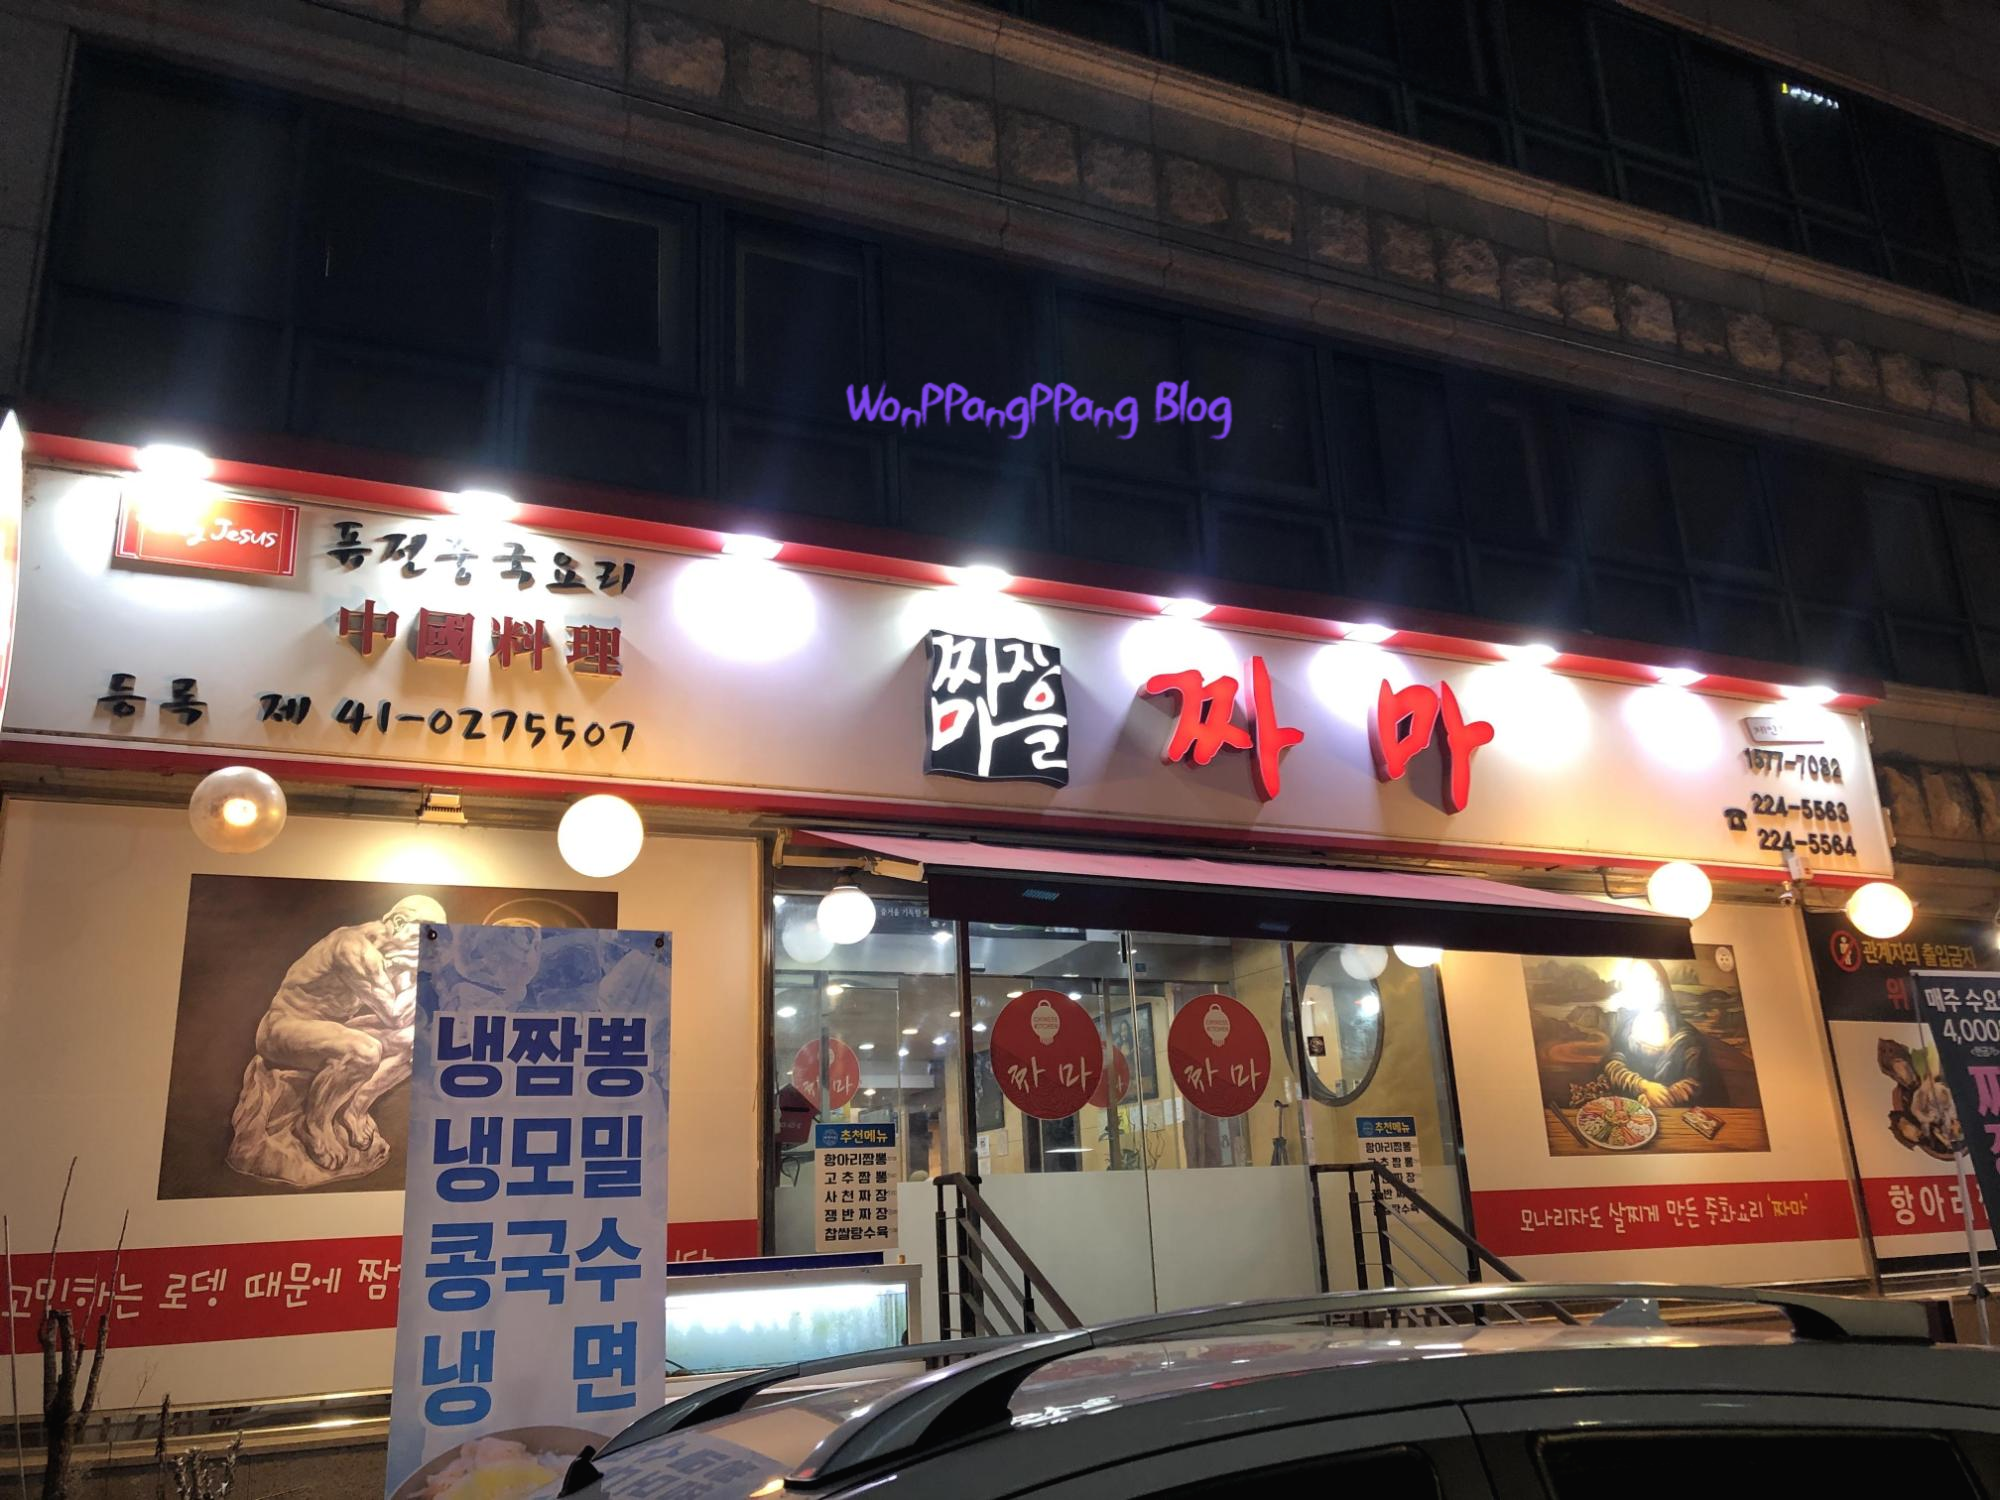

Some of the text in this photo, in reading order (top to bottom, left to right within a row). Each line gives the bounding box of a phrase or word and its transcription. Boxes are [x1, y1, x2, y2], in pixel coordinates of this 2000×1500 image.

[210, 517, 279, 548] Jesus
[338, 599, 624, 680] 中國料理
[259, 693, 311, 725] 제
[334, 697, 636, 754] 41-0275507
[1743, 748, 1843, 784] 1577-7082
[1751, 793, 1850, 823] 224-5563
[1757, 829, 1857, 857] 224-5564
[1861, 940, 1977, 968] 관계자외 출입금지
[1924, 987, 2000, 1014] 매주 수요
[1943, 1019, 2000, 1045] 4,000
[436, 1015, 649, 1099] 냉짬뽕
[840, 1128, 889, 1144] 추천메뉴
[1374, 1121, 1411, 1135] 추천메뉴
[433, 1115, 645, 1203] 냉모밀
[823, 1152, 887, 1168] 항아리짬뽕
[1520, 1206, 1604, 1232] 모나리자도
[1608, 1202, 1660, 1234] 살찌게
[1666, 1197, 1700, 1229] 만든
[1704, 1196, 1764, 1226] 중화요리
[1887, 1183, 1990, 1226] 항아리
[824, 1225, 889, 1241] 찹쌀탕수육
[425, 1217, 643, 1313] 콩국수
[1, 1258, 402, 1320] 고민하는 로뎅 때문에 짬
